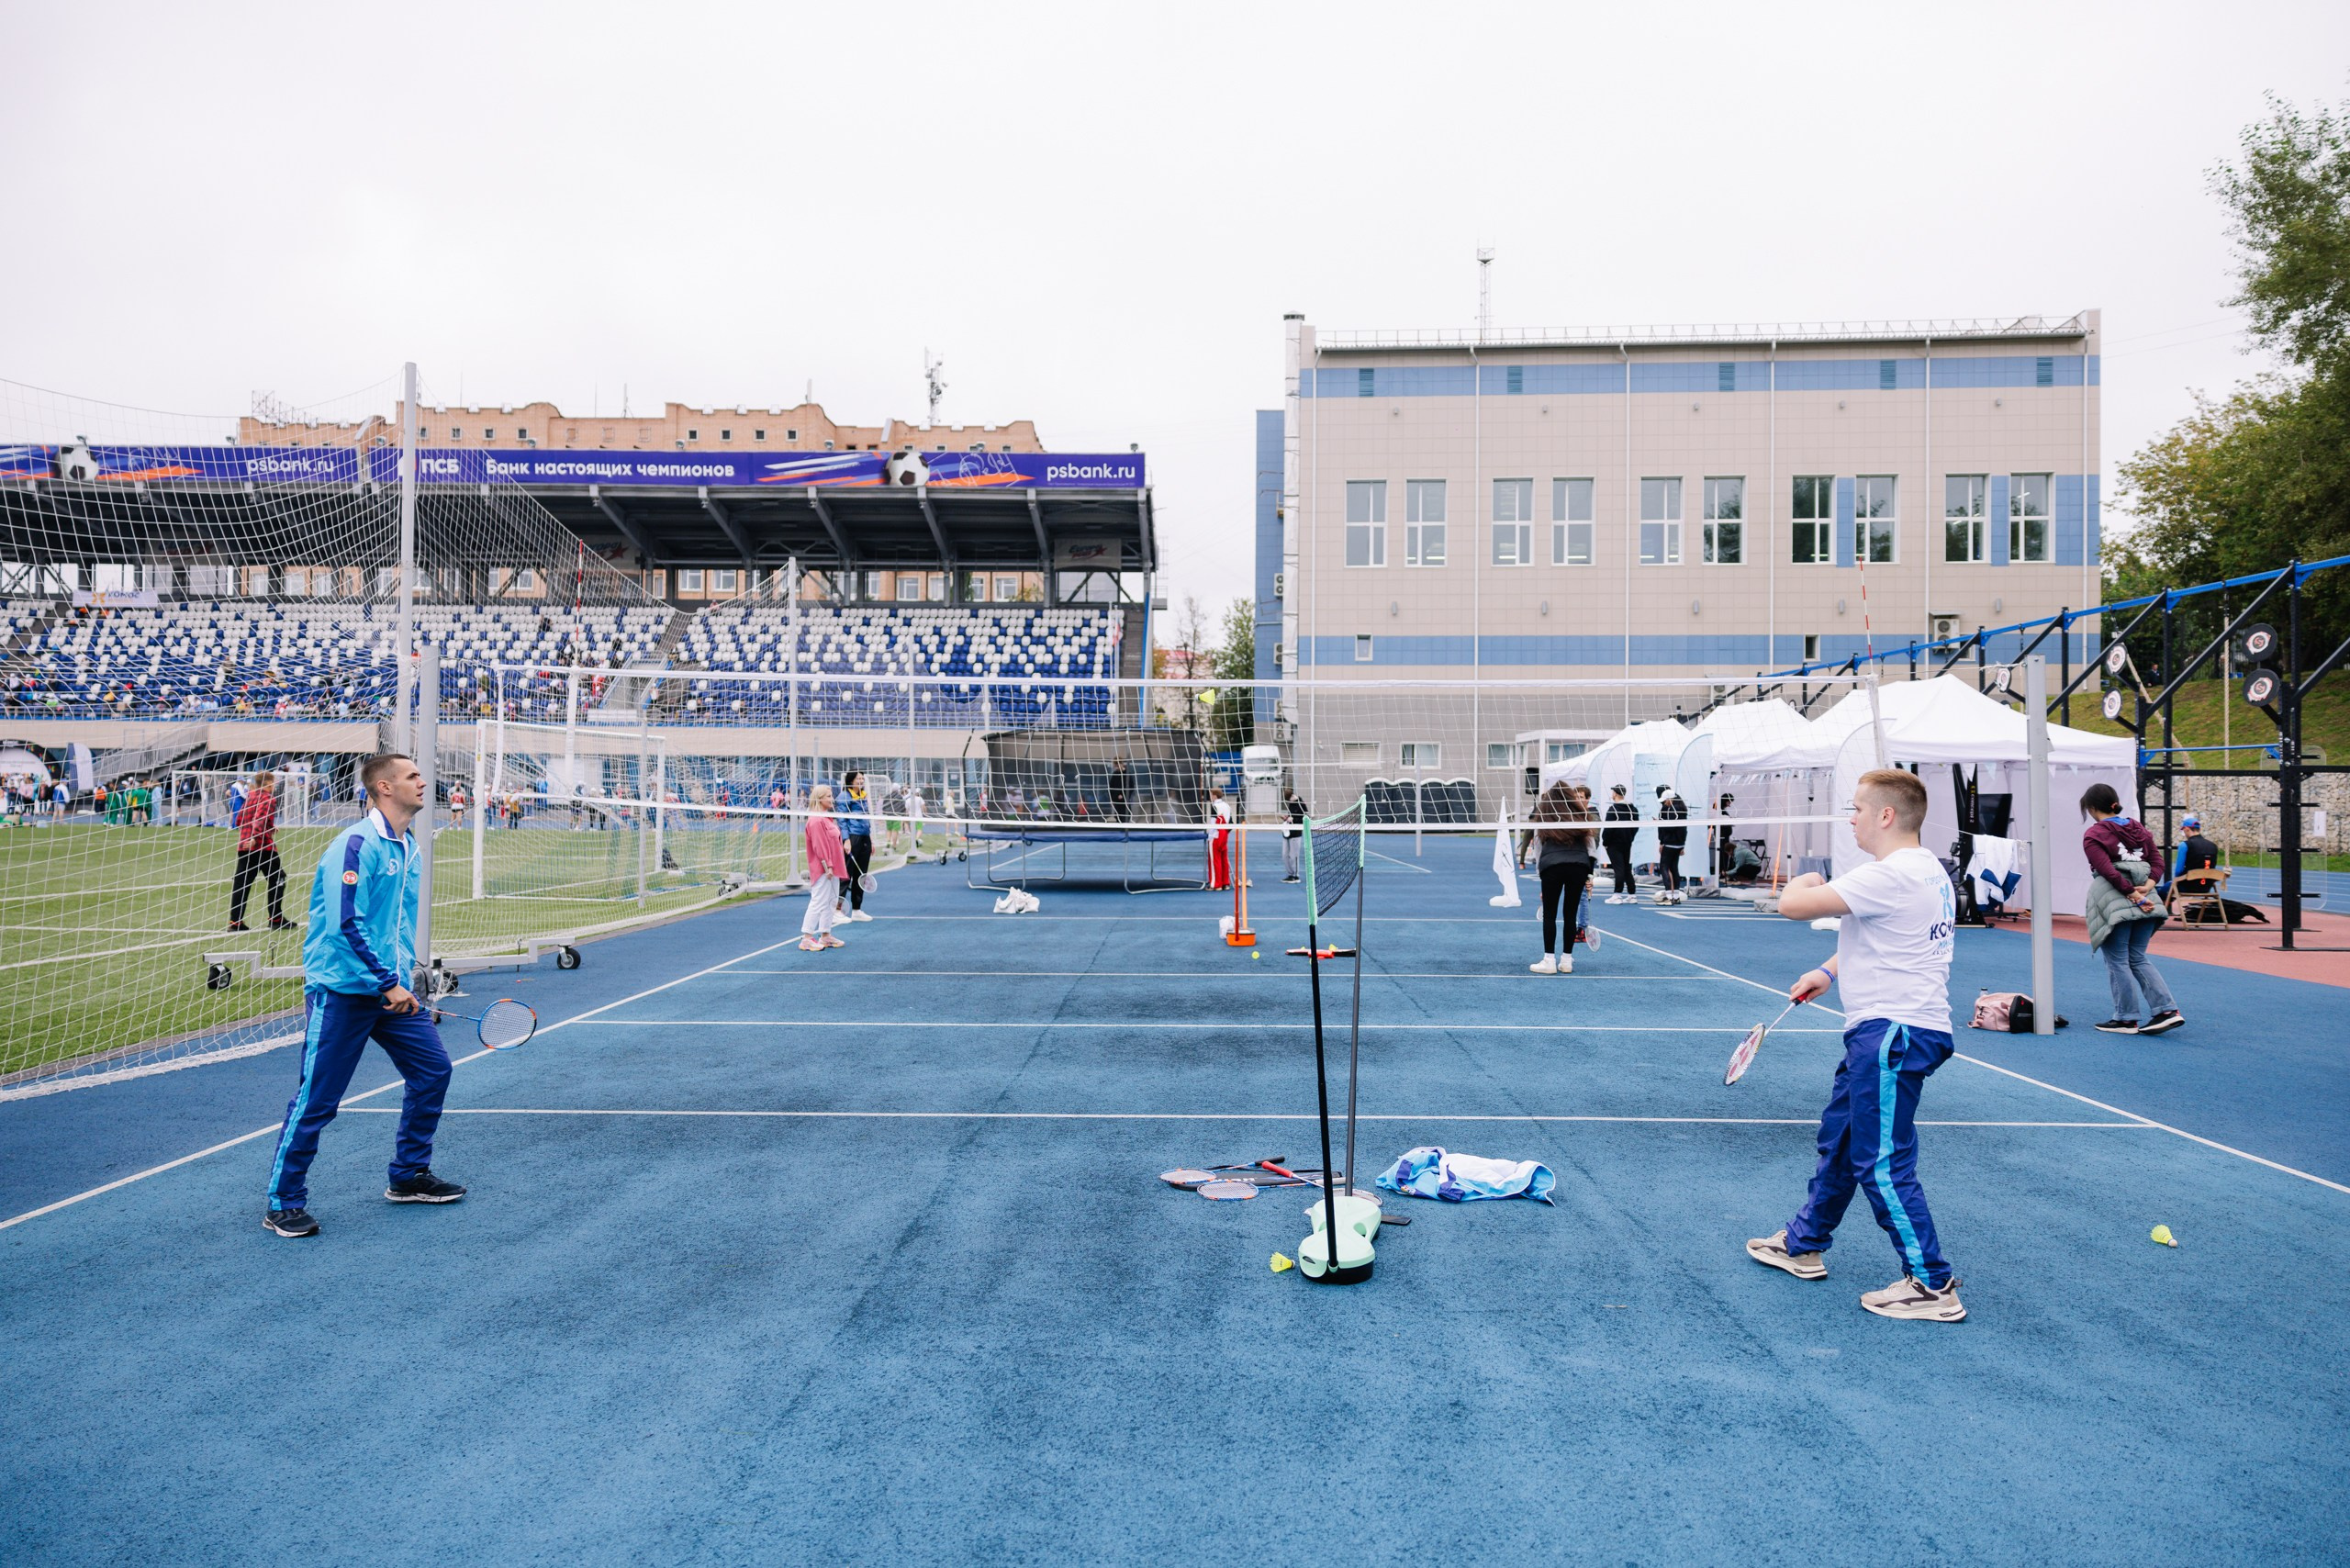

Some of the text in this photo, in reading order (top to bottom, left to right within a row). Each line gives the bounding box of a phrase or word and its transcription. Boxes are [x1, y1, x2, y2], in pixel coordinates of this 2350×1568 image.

[247, 457, 334, 475] psbank.ru
[420, 458, 460, 474] ПСБ
[486, 459, 734, 477] Банк настоящих чемпионов
[1046, 463, 1136, 482] psbank.ru
